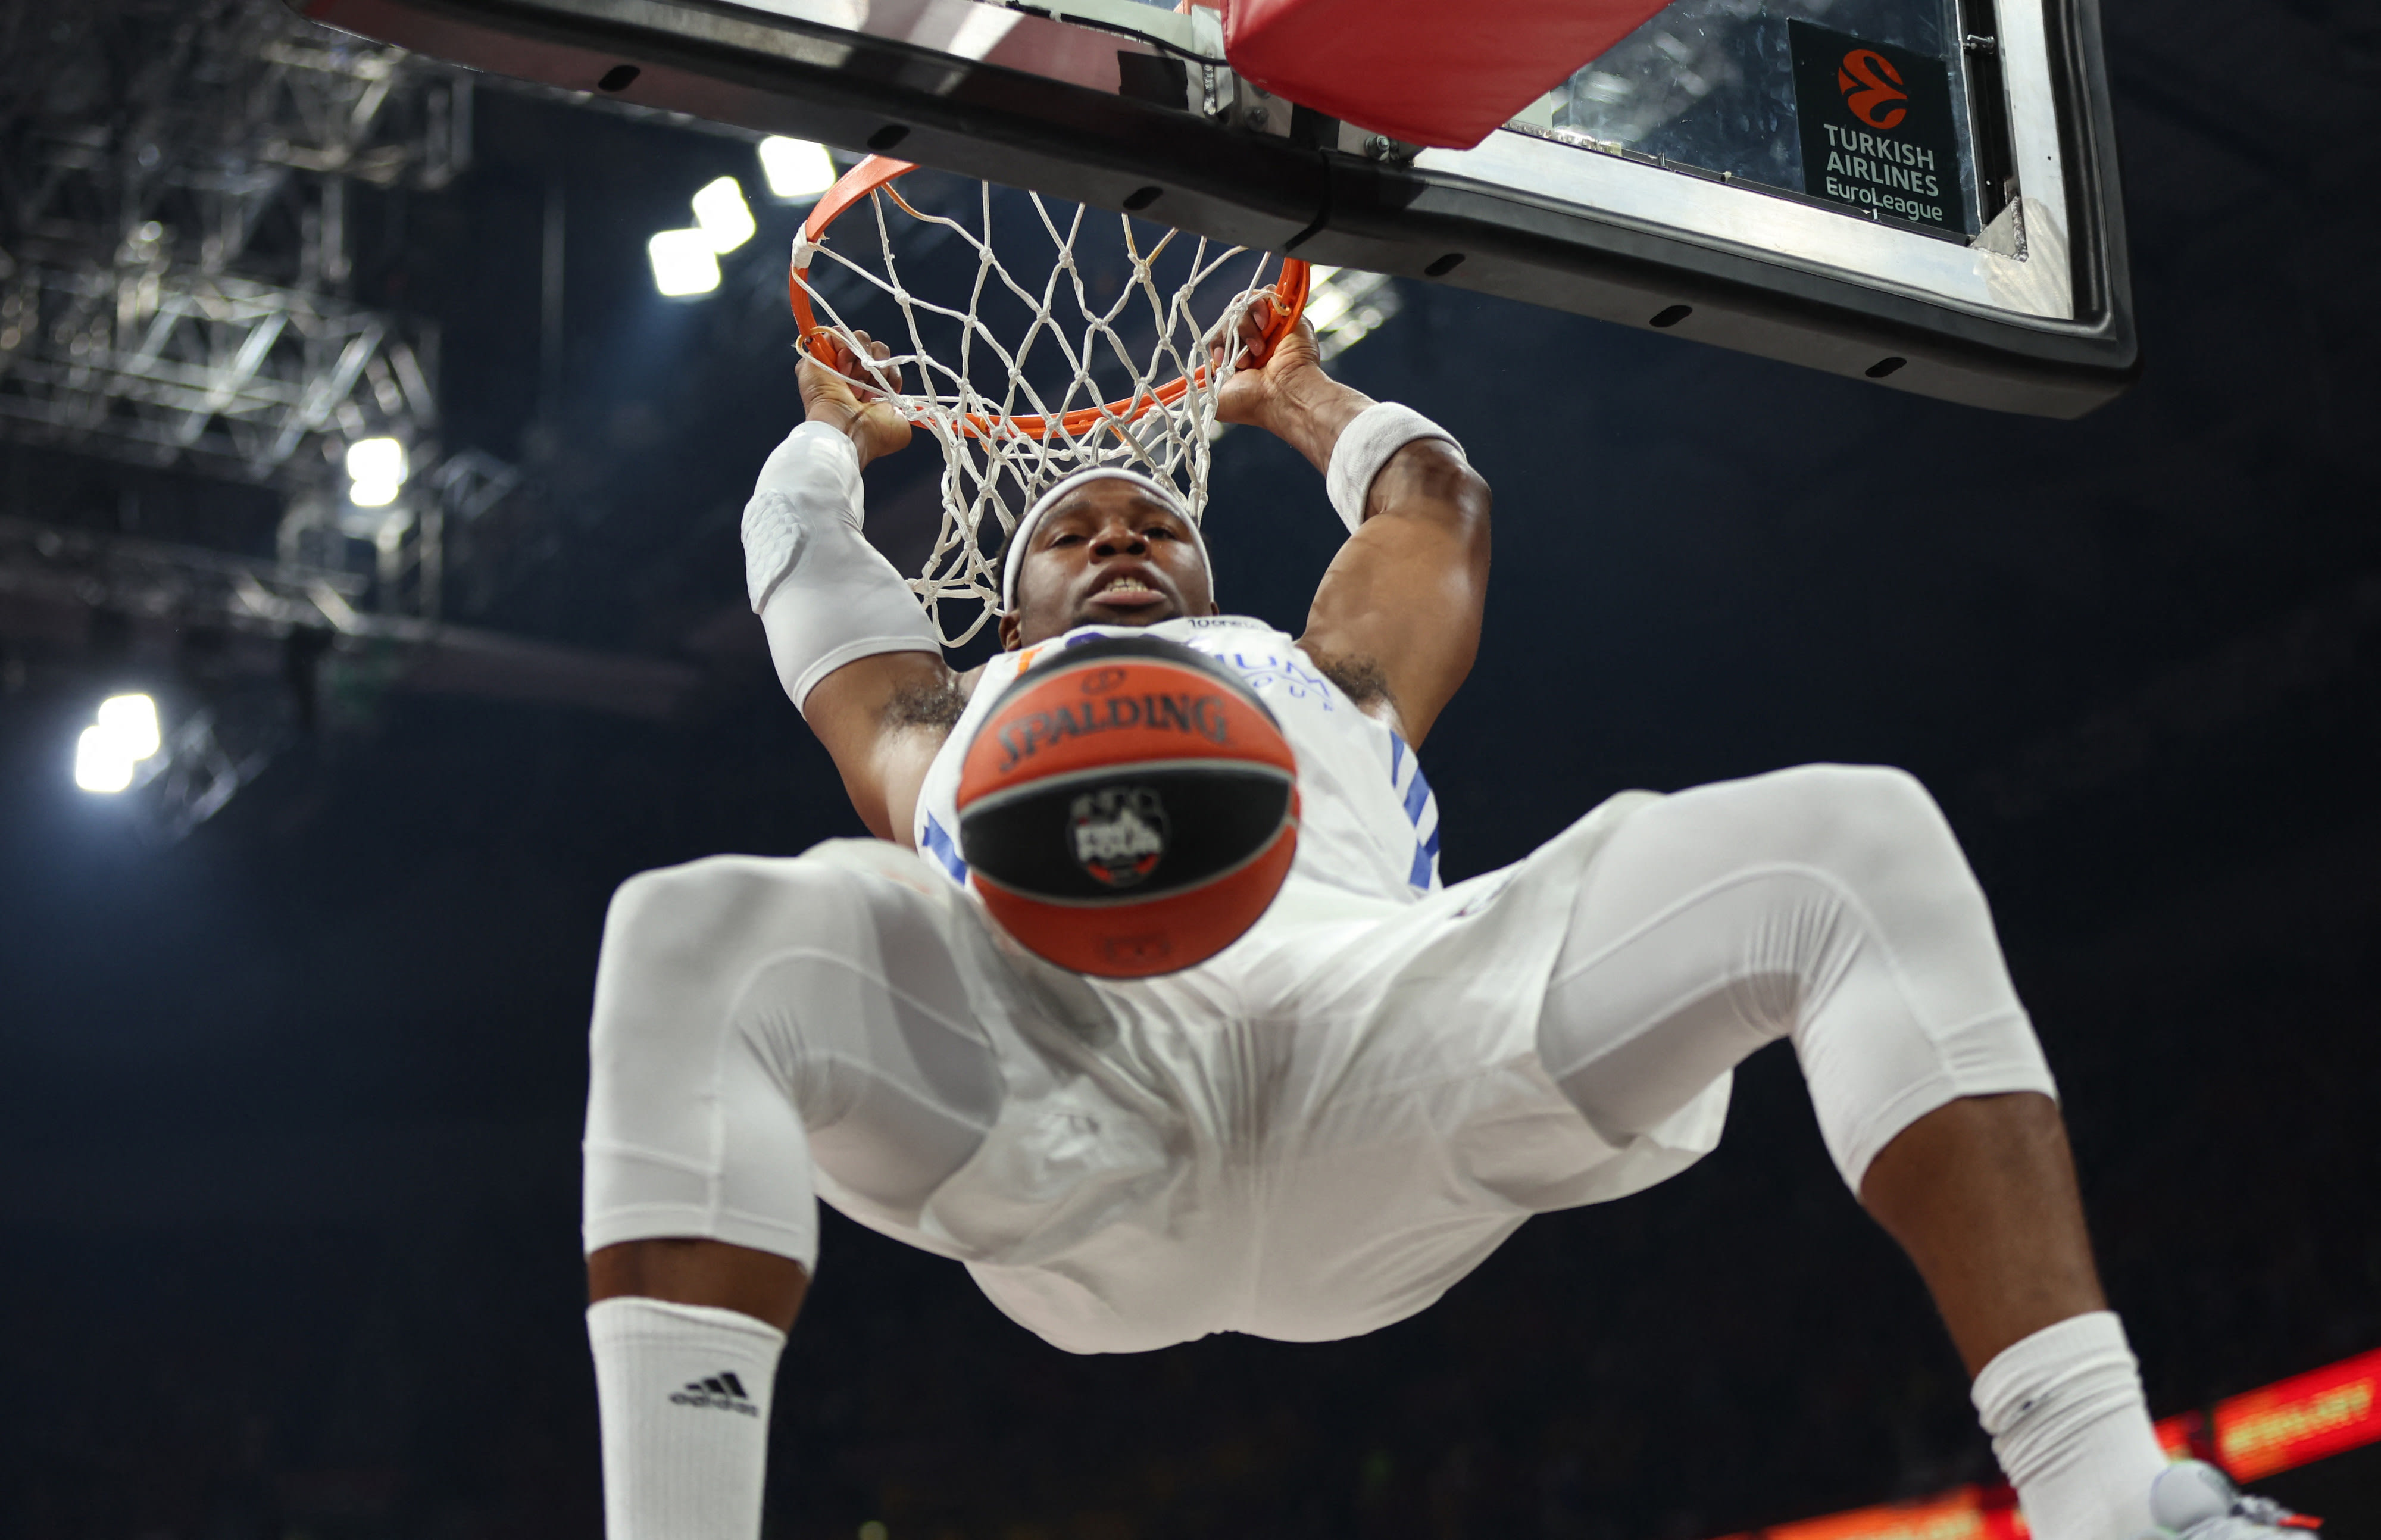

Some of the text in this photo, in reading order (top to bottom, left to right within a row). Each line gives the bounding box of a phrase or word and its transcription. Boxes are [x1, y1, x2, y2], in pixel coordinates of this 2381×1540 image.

[1823, 123, 1935, 171] TURKISH
[1826, 151, 1939, 197] AIRLINES
[1826, 176, 1943, 221] EuroLeague
[999, 693, 1227, 772] SPALDING
